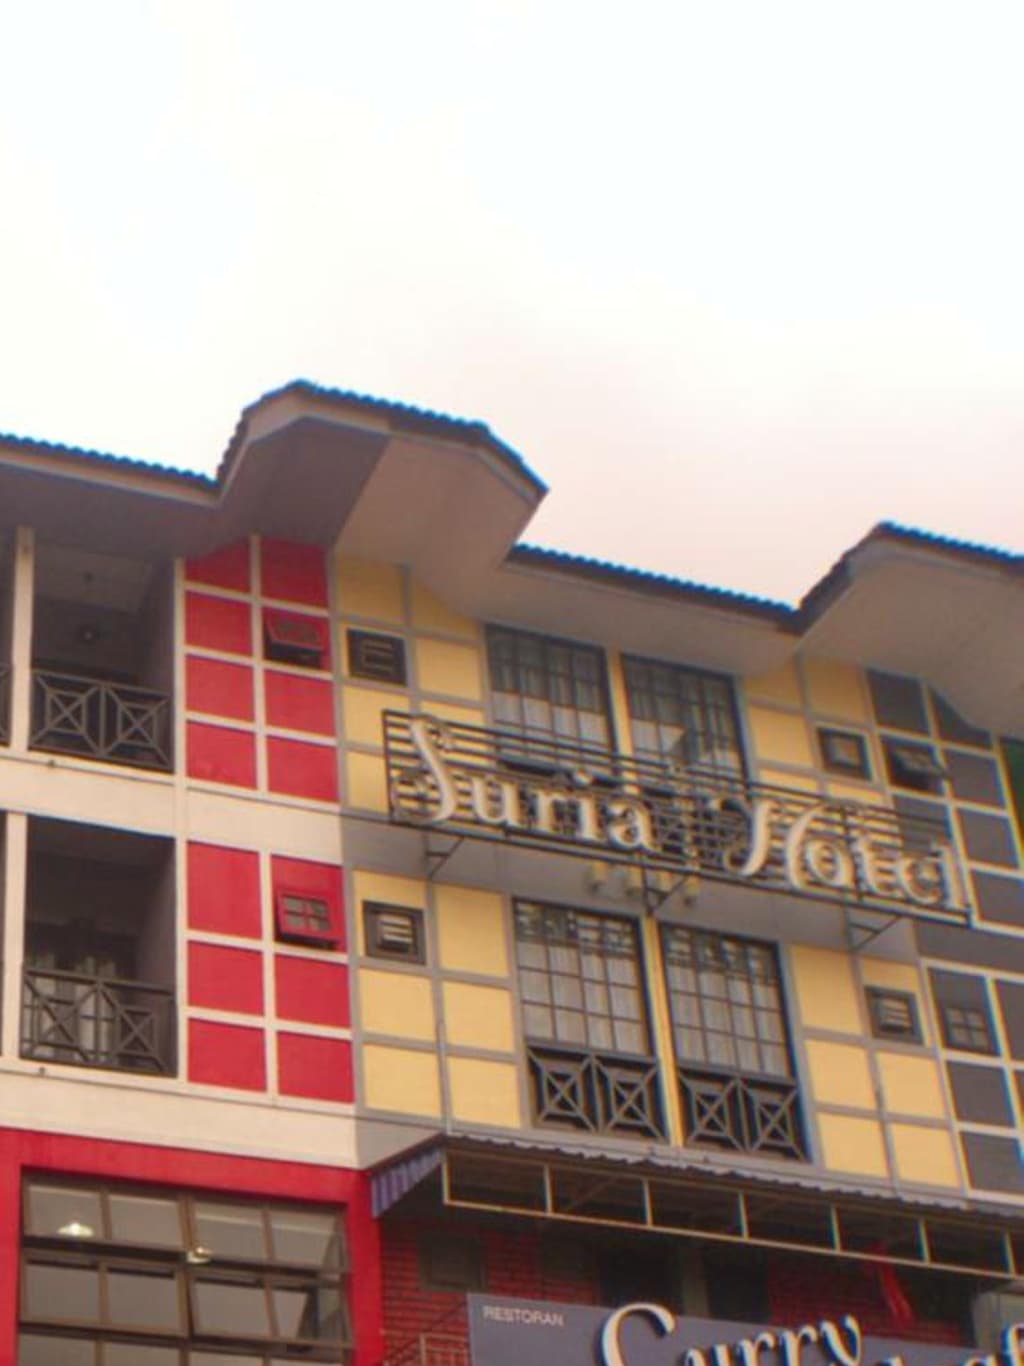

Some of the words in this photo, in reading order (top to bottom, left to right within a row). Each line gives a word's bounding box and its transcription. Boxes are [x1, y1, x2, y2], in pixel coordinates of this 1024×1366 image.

[392, 714, 662, 853] Suria
[706, 795, 967, 913] Hotel
[482, 1304, 565, 1328] RESTORAN
